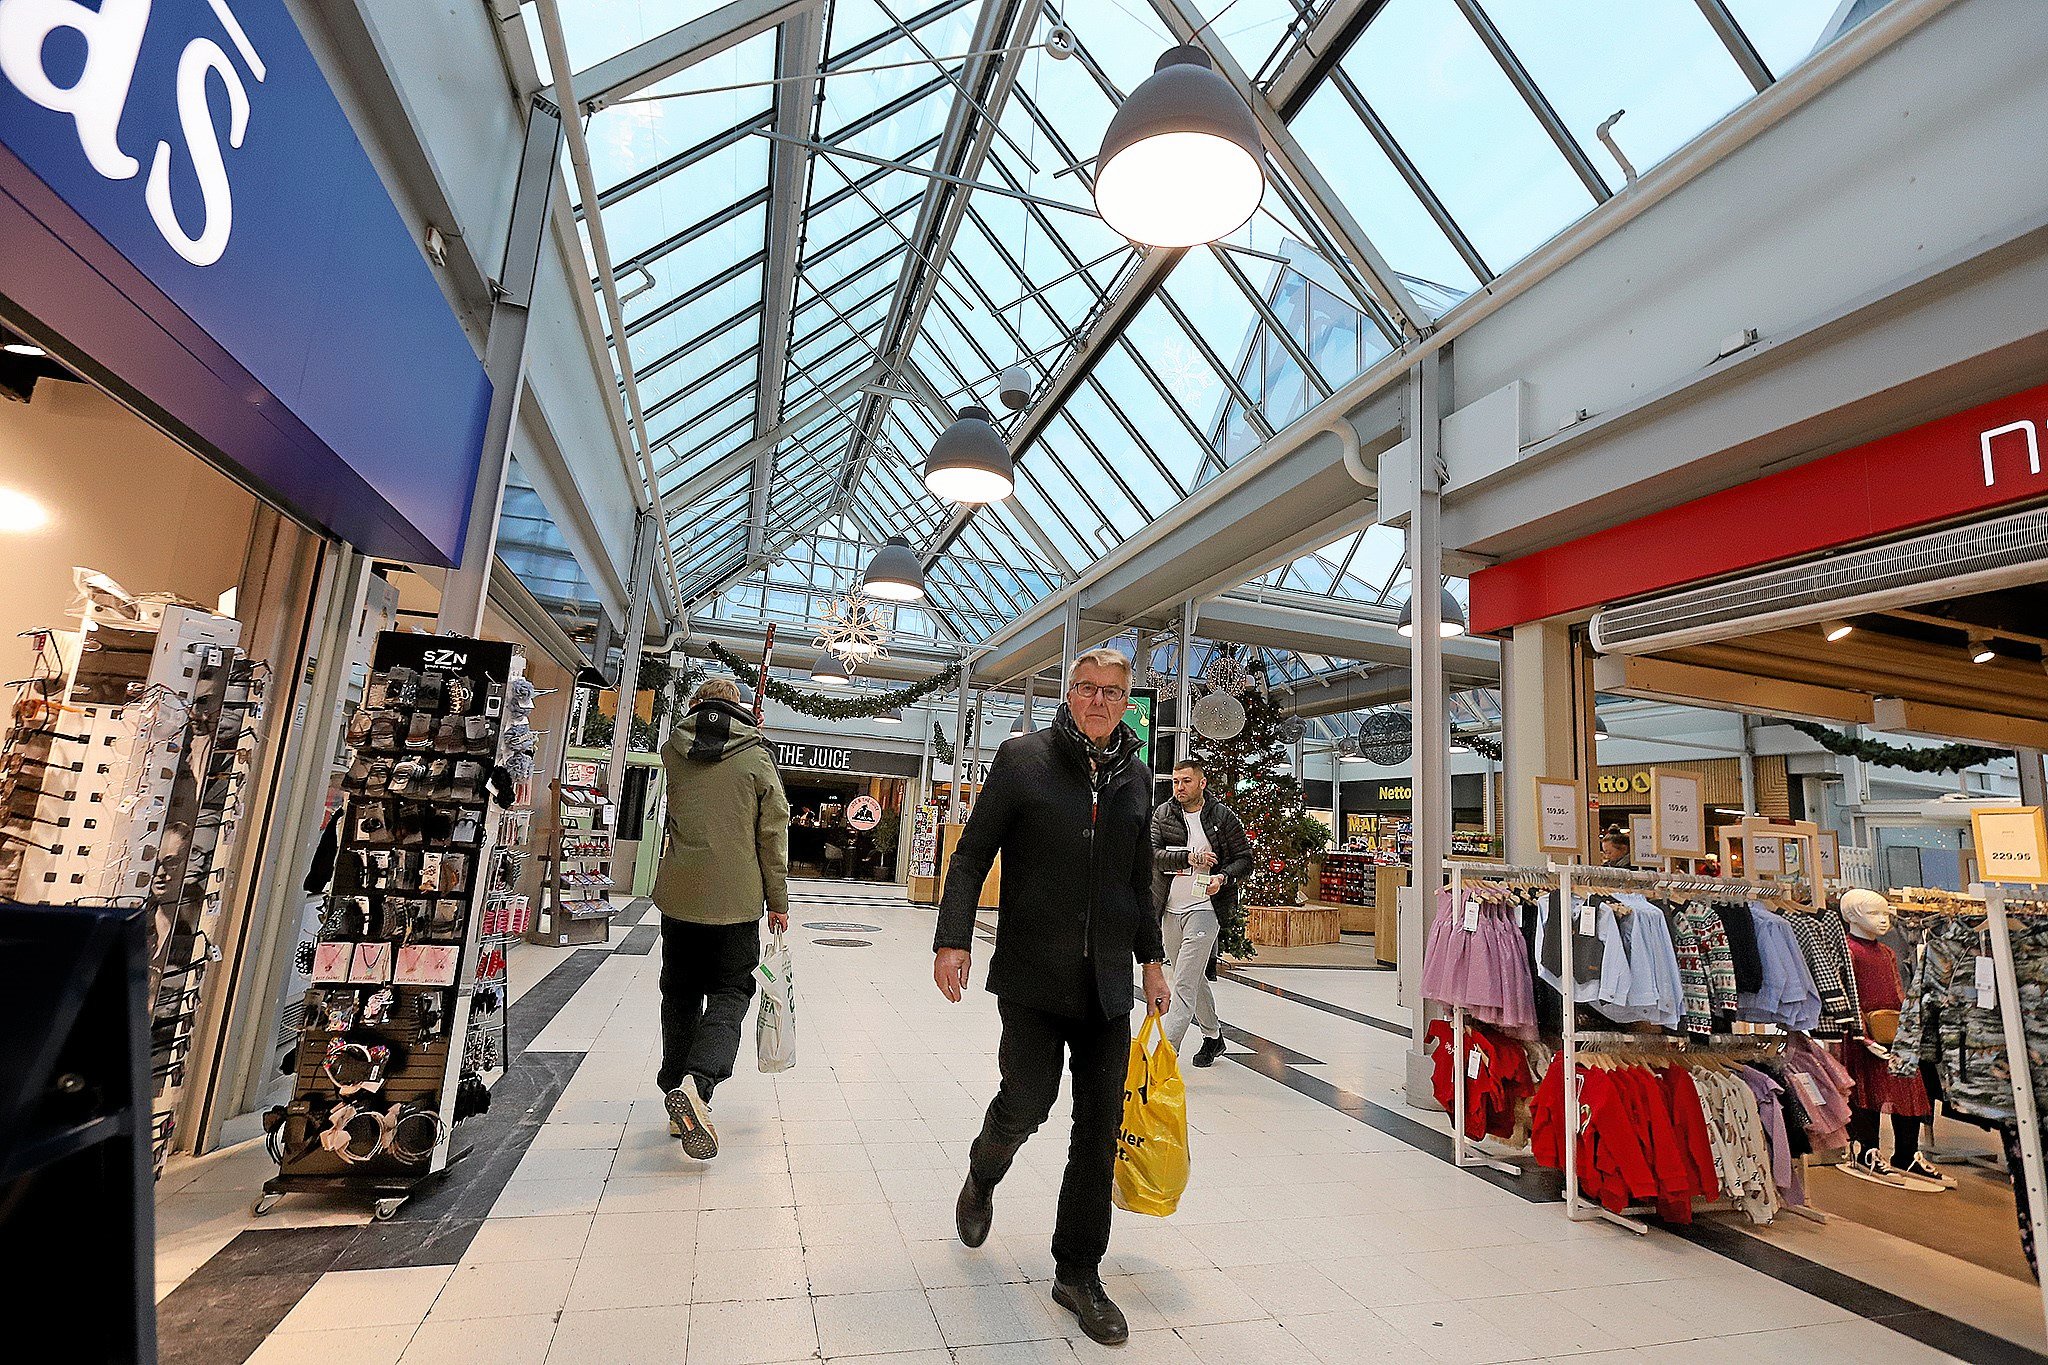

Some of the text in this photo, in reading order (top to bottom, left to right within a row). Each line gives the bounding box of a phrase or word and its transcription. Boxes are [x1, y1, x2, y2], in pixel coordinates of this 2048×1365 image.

[423, 649, 468, 665] SZN
[777, 744, 852, 769] THE JUICE
[1378, 786, 1412, 800] Netto
[1754, 845, 1775, 854] 50%
